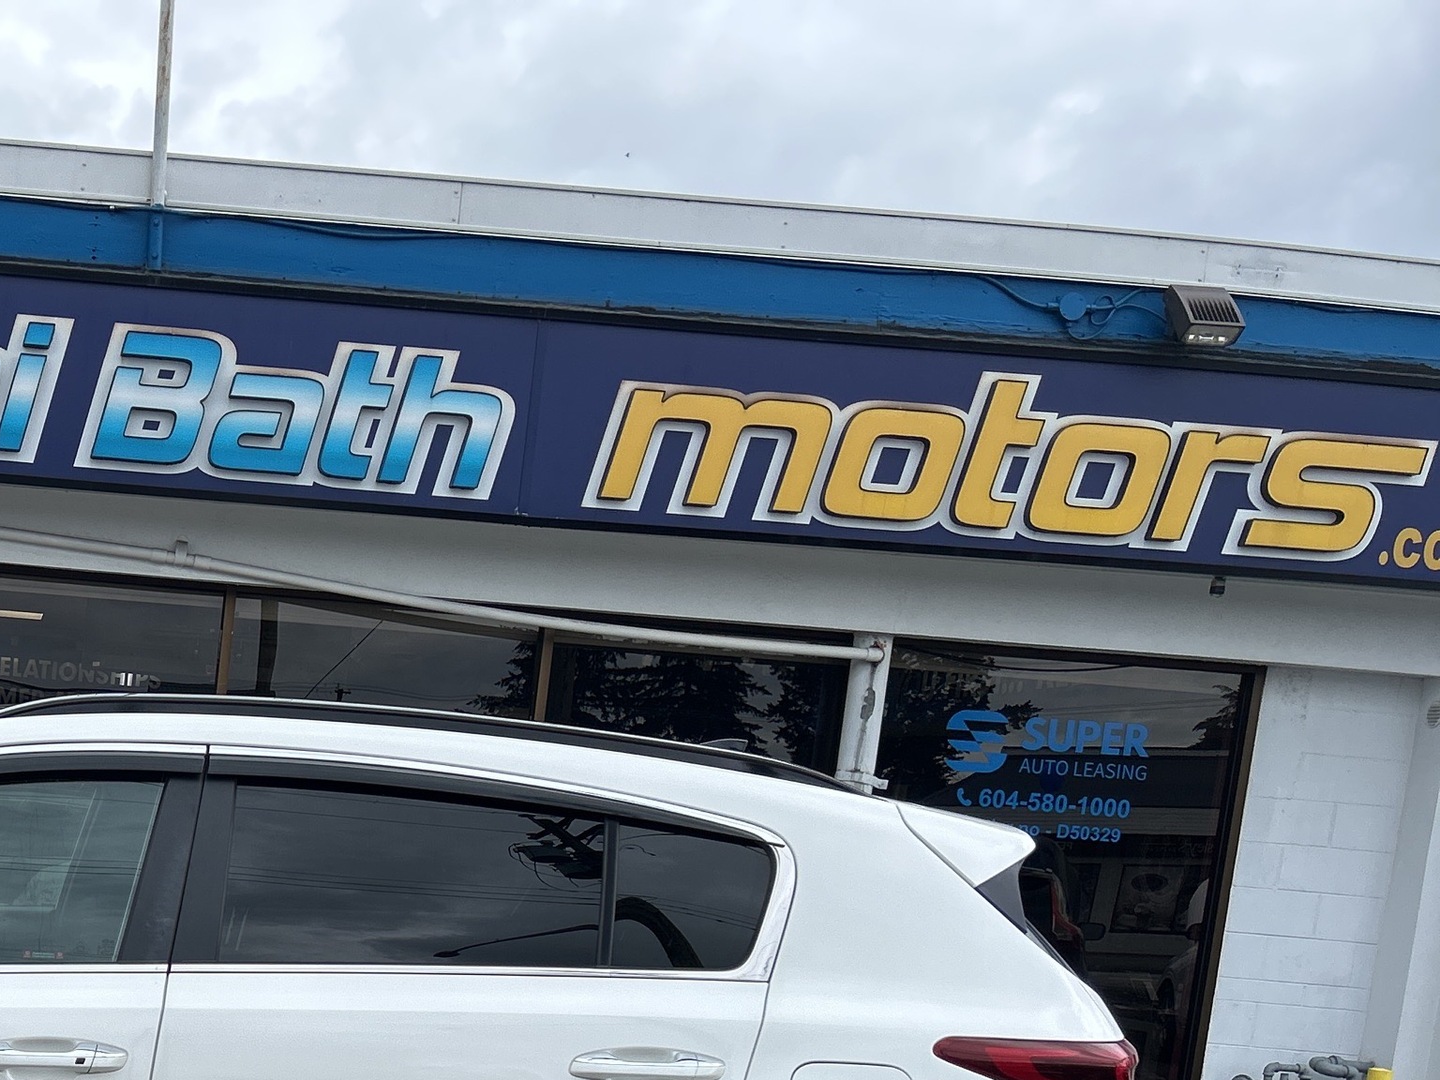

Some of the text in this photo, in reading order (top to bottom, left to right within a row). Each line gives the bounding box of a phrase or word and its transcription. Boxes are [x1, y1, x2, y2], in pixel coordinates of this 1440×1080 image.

[75, 322, 515, 500] Bath
[581, 371, 1436, 560] motors
[1022, 716, 1150, 758] SUPER
[1018, 758, 1148, 781] AUTO LEASING
[978, 788, 1131, 819] 604-580-1000
[1056, 823, 1122, 843] D50329
